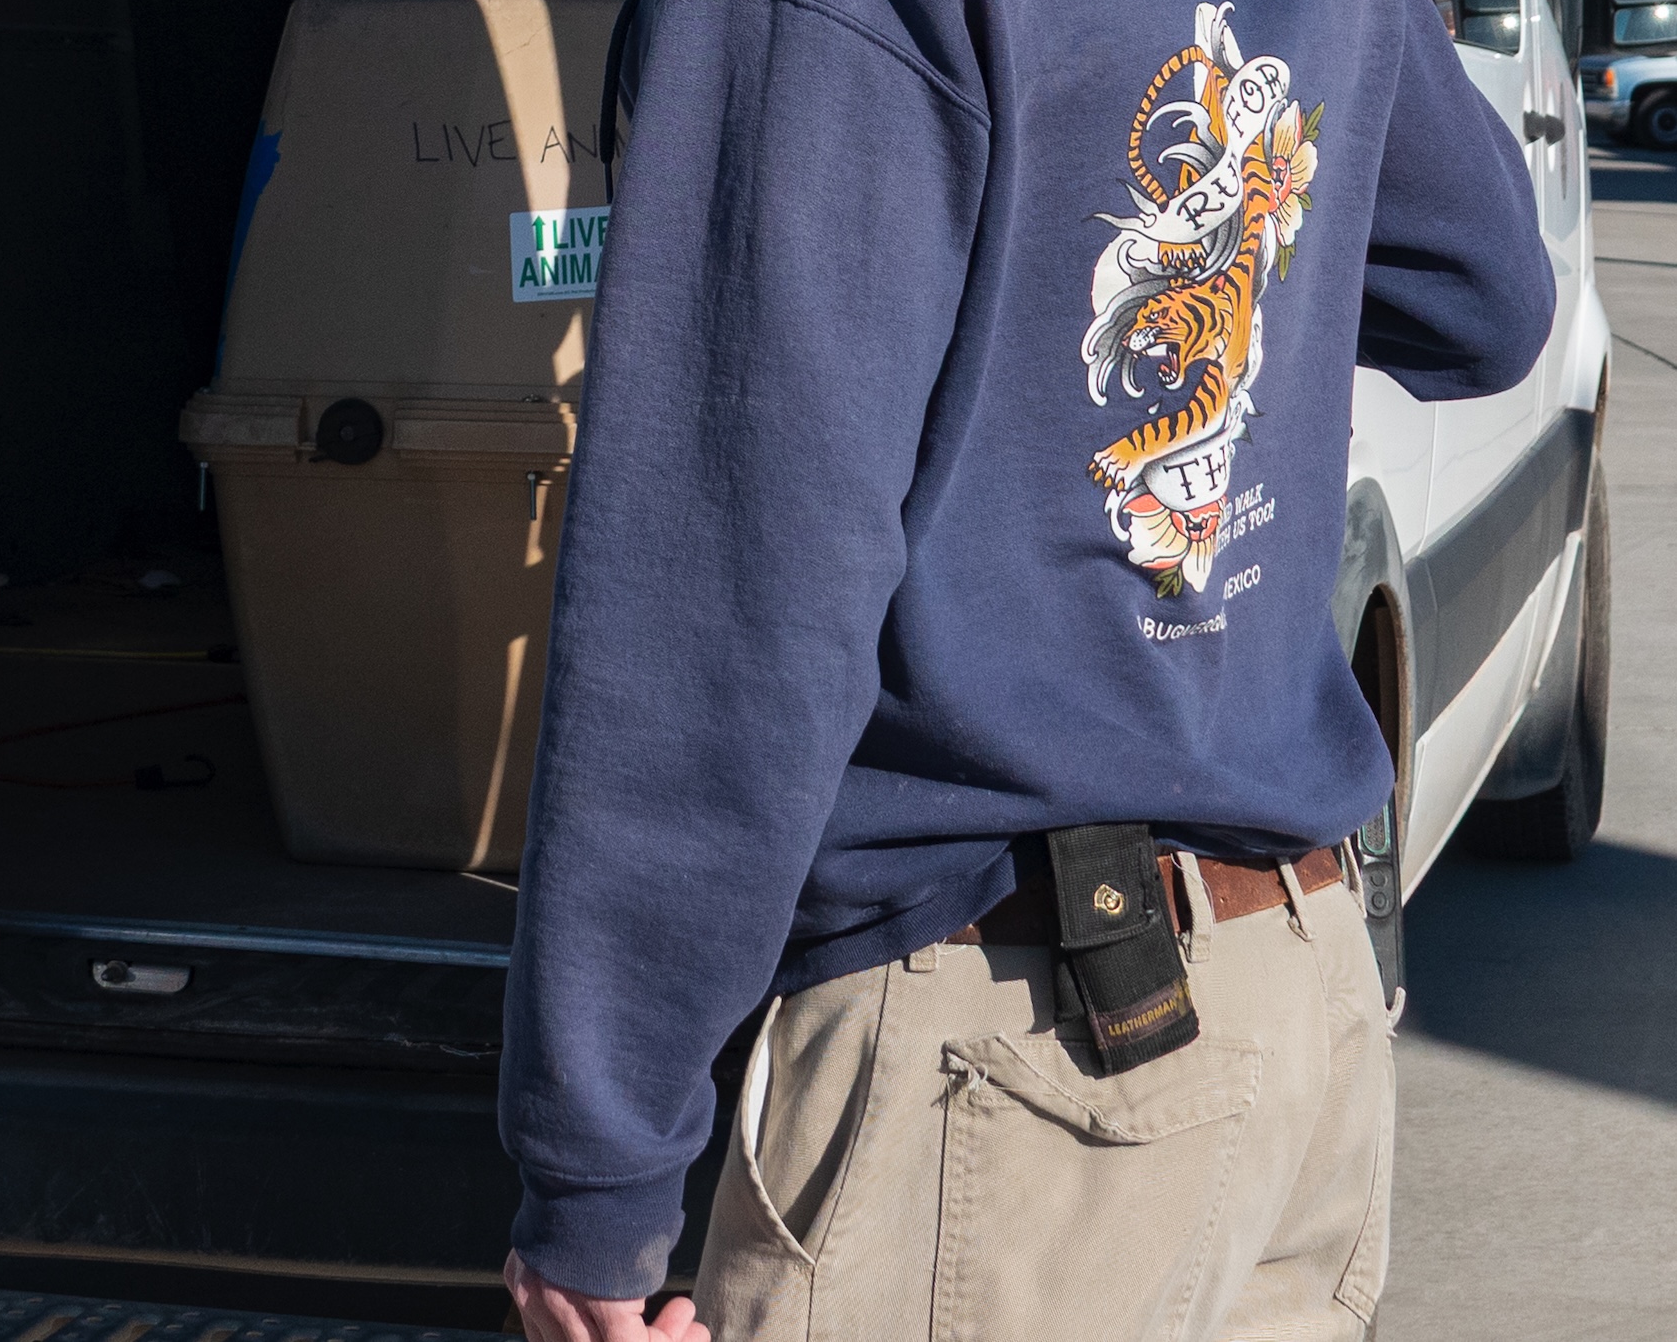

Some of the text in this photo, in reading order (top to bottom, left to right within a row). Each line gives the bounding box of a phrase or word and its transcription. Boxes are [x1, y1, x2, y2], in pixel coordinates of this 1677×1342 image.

[1226, 63, 1286, 138] FOR
[413, 120, 517, 167] LIVE
[519, 252, 602, 288] ANIM
[1233, 516, 1247, 540] US
[1248, 497, 1275, 531] TOO!
[1235, 483, 1264, 515] WALK
[1108, 998, 1178, 1037] LEATHERMAN
